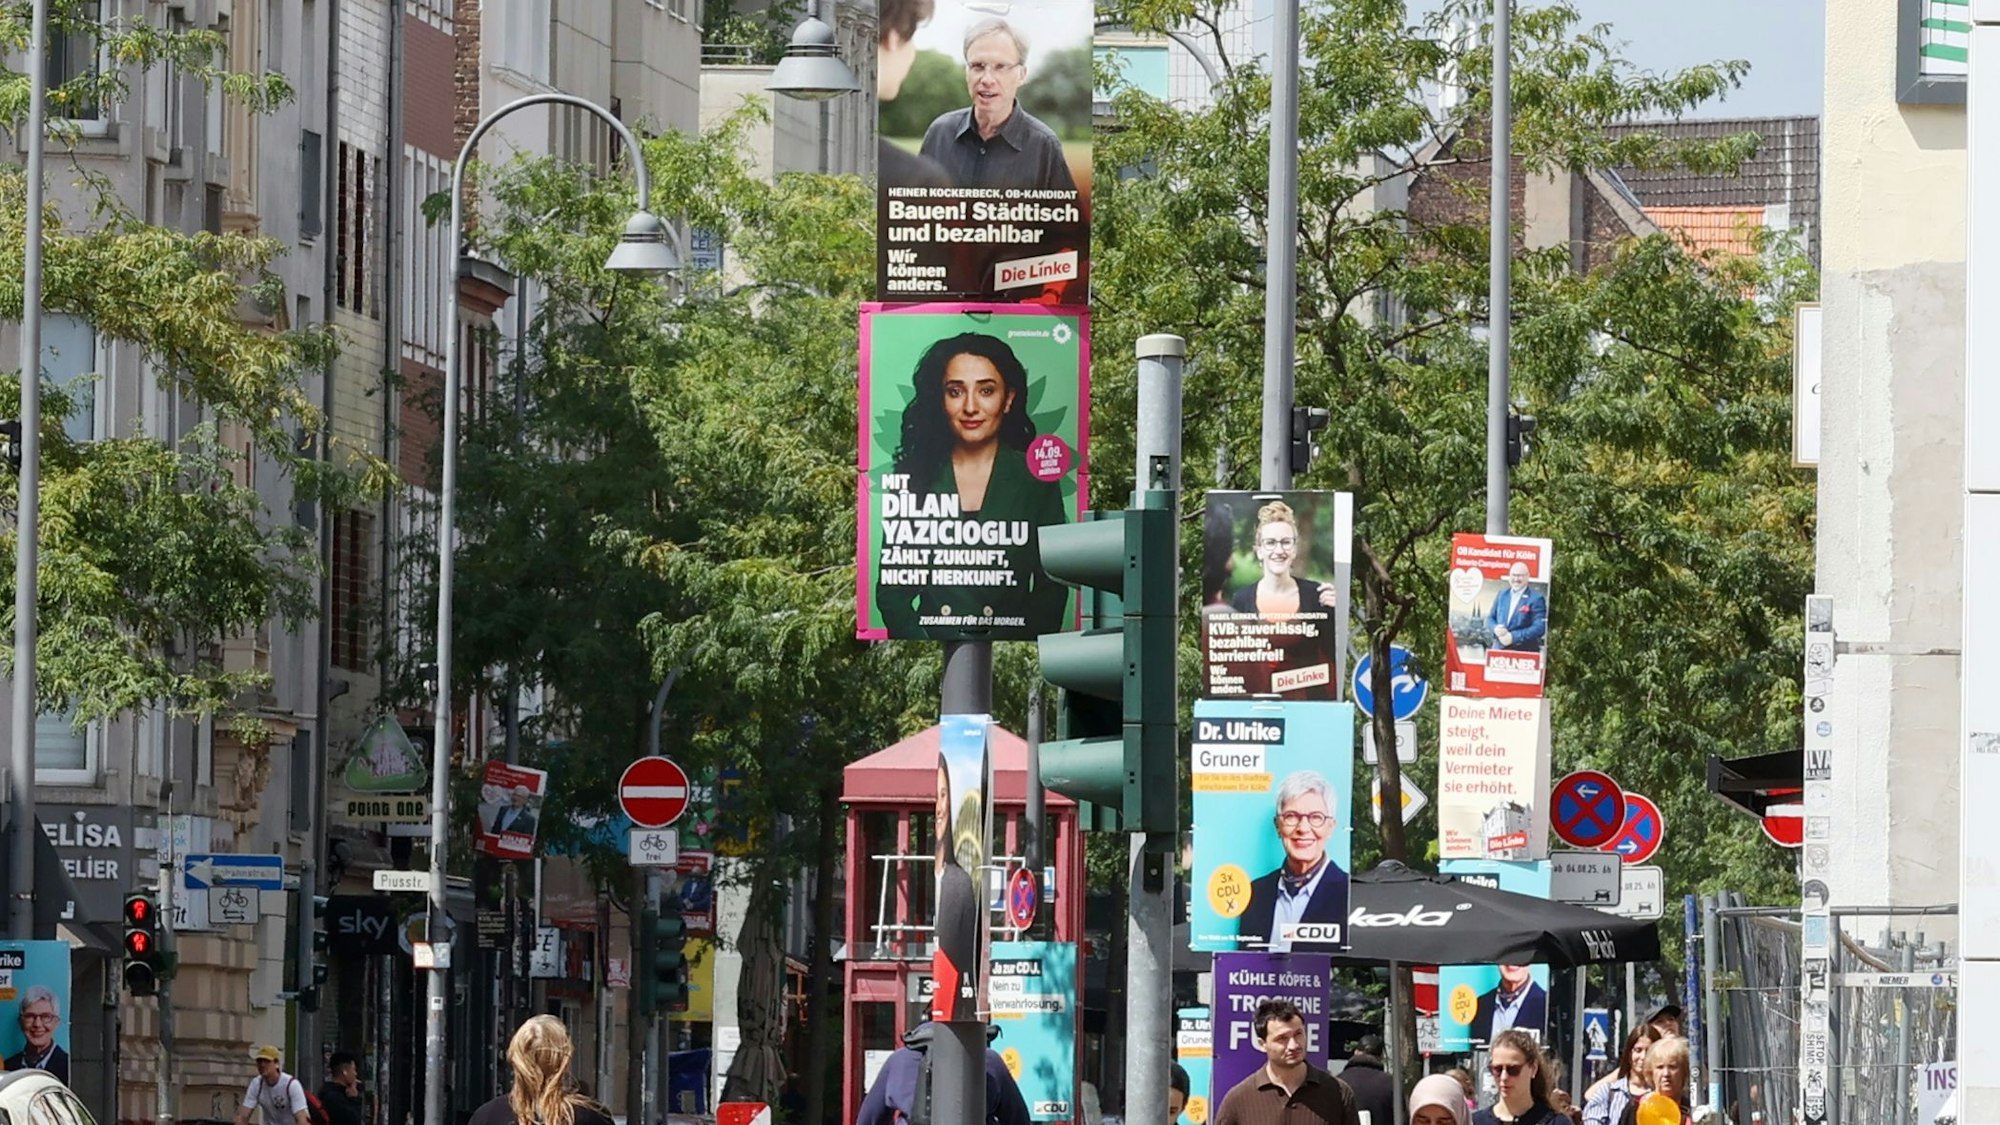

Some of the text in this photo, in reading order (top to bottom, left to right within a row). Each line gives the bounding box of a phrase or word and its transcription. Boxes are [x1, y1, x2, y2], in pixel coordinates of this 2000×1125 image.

[888, 187, 1077, 200] HEINER KOCKERBECK, OB-KANDIDAT
[888, 201, 1079, 222] Bauen! Städtisch
[888, 224, 1043, 243] und bezahlbar
[887, 264, 946, 278] können
[1001, 268, 1026, 283] Die
[887, 278, 948, 291] anders.
[1034, 446, 1062, 460] 14.09.
[881, 474, 910, 490] MIT
[881, 521, 1028, 546] YAZICIOGLU
[881, 549, 1009, 569] ZÄHLT ZUKUNFT,
[1502, 549, 1515, 559] für
[1516, 550, 1537, 561] Köln
[881, 569, 1018, 587] NICHT HERKUNFT.
[919, 616, 961, 626] ZUSAMMEN
[962, 615, 977, 626] FÜR
[978, 617, 993, 626] DAS
[1209, 621, 1319, 638] KVB: zuverlässig,
[1209, 636, 1272, 650] bezahlbar,
[1209, 649, 1285, 662] barrierefrei!
[1277, 677, 1294, 688] Die
[1449, 705, 1532, 721] Deine Miete
[1199, 721, 1281, 741] Dr. Ulrike
[1447, 726, 1489, 742] steigt,
[1446, 744, 1506, 757] weil dein
[1199, 750, 1260, 768] Gruner
[1446, 762, 1513, 776] Vermieter
[1444, 780, 1517, 795] sie erhöht.
[1489, 837, 1503, 848] Die
[646, 851, 661, 862] frei
[1553, 864, 1563, 873] ab
[381, 873, 424, 889] Piusstr.
[1220, 873, 1234, 884] 3x
[1217, 885, 1240, 897] CDU
[1348, 904, 1454, 927] kola
[339, 908, 389, 940] sky
[1296, 927, 1337, 939] CDU
[992, 962, 1002, 975] Ja
[1228, 969, 1321, 988] KÜHLE KÖPFE &
[1878, 976, 1910, 985] NIEMER
[992, 981, 1021, 992] Nein zu
[993, 998, 1063, 1012] Verwahrlosung.
[1228, 994, 1321, 1015] TRENE
[1181, 1019, 1195, 1030] Dr.
[1421, 1041, 1436, 1049] frei
[1927, 1067, 1957, 1091] INS
[1043, 1102, 1068, 1113] CDU
